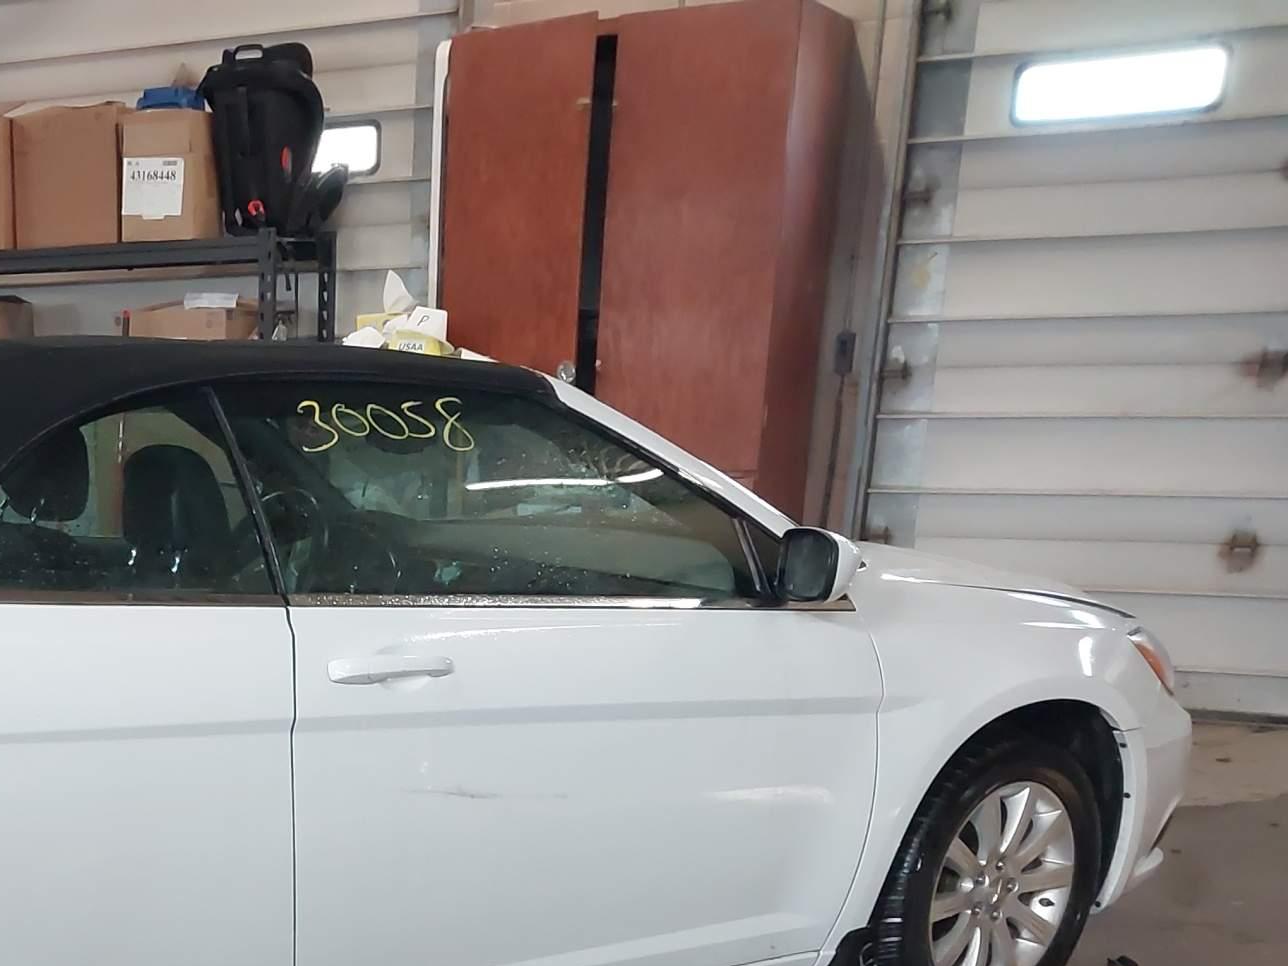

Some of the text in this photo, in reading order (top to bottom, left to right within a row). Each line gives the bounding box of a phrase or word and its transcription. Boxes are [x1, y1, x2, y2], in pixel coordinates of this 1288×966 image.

[130, 170, 177, 181] 43168448
[416, 315, 430, 326] P
[398, 343, 424, 351] USAA
[296, 397, 475, 452] 30058
